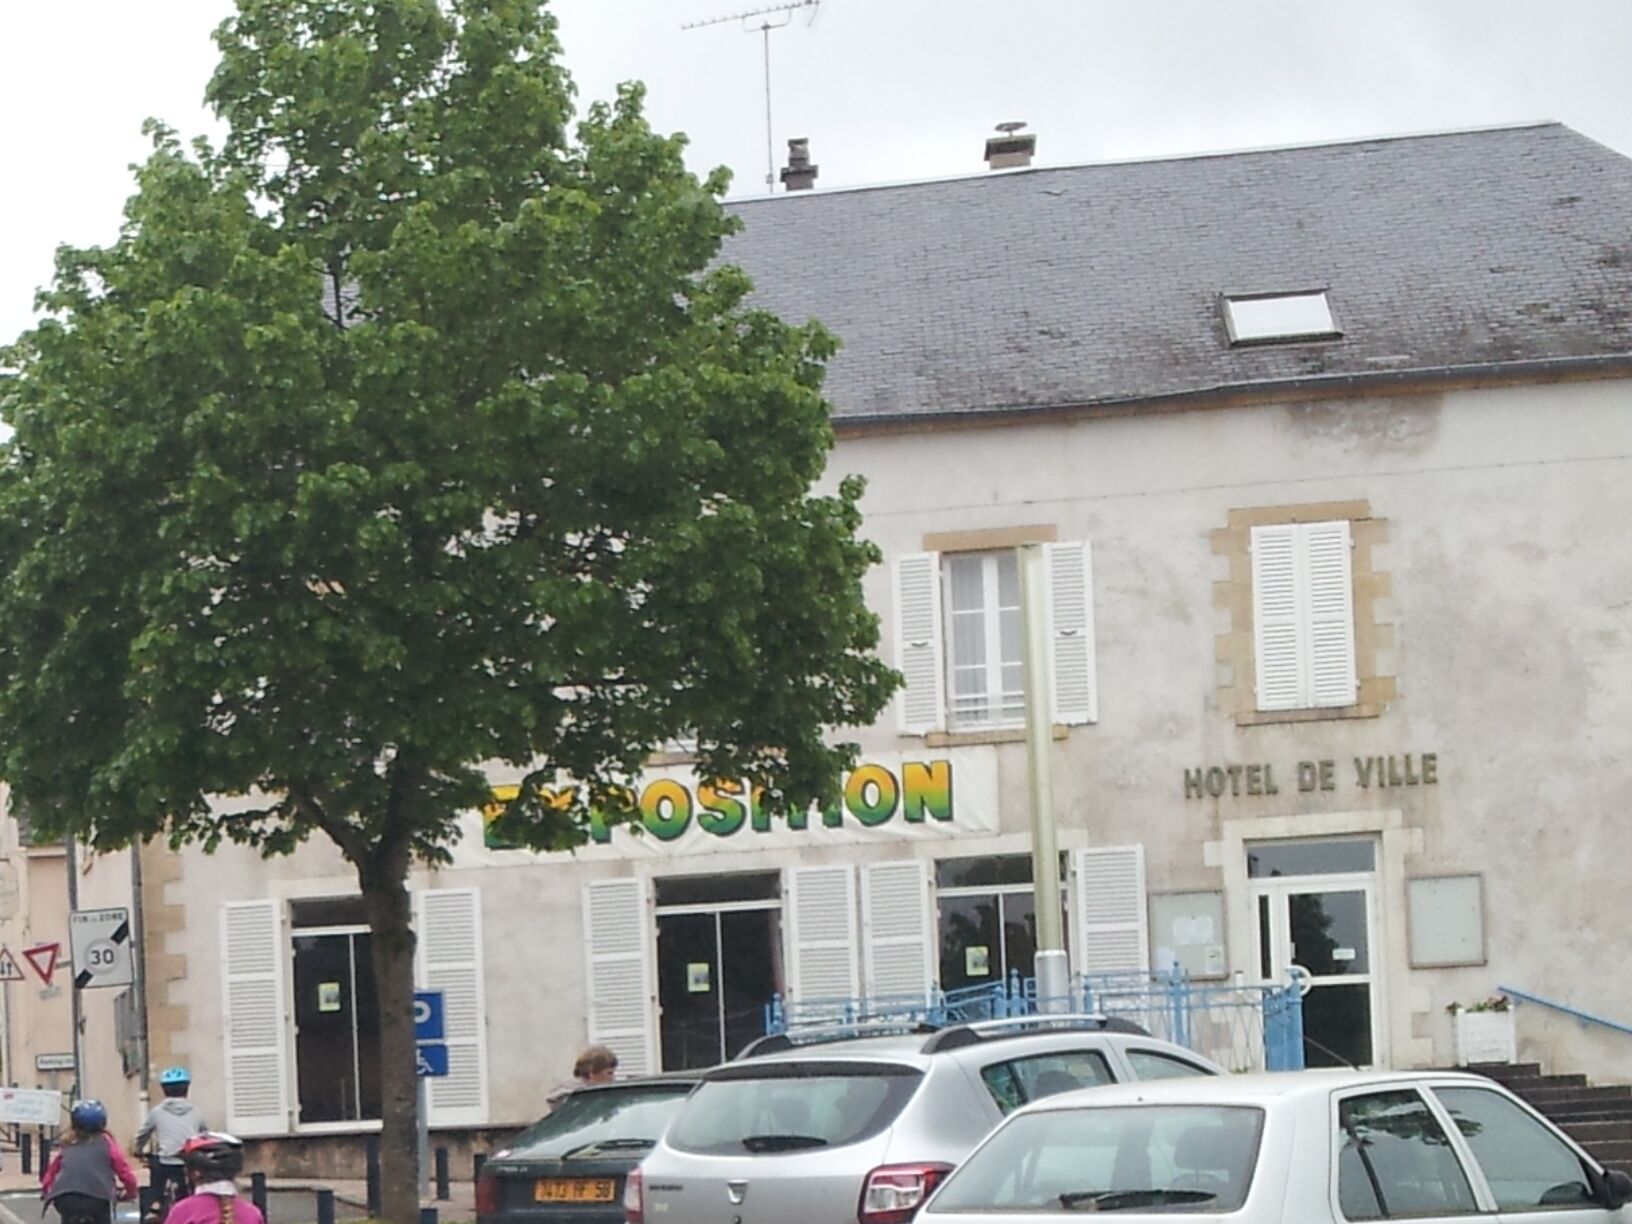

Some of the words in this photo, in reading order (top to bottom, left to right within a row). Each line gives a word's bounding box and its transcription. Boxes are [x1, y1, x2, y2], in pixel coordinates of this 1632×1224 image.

[1183, 764, 1279, 800] HOTEL
[1298, 759, 1335, 793] DE
[1353, 753, 1439, 789] VILLE
[90, 949, 115, 966] 30
